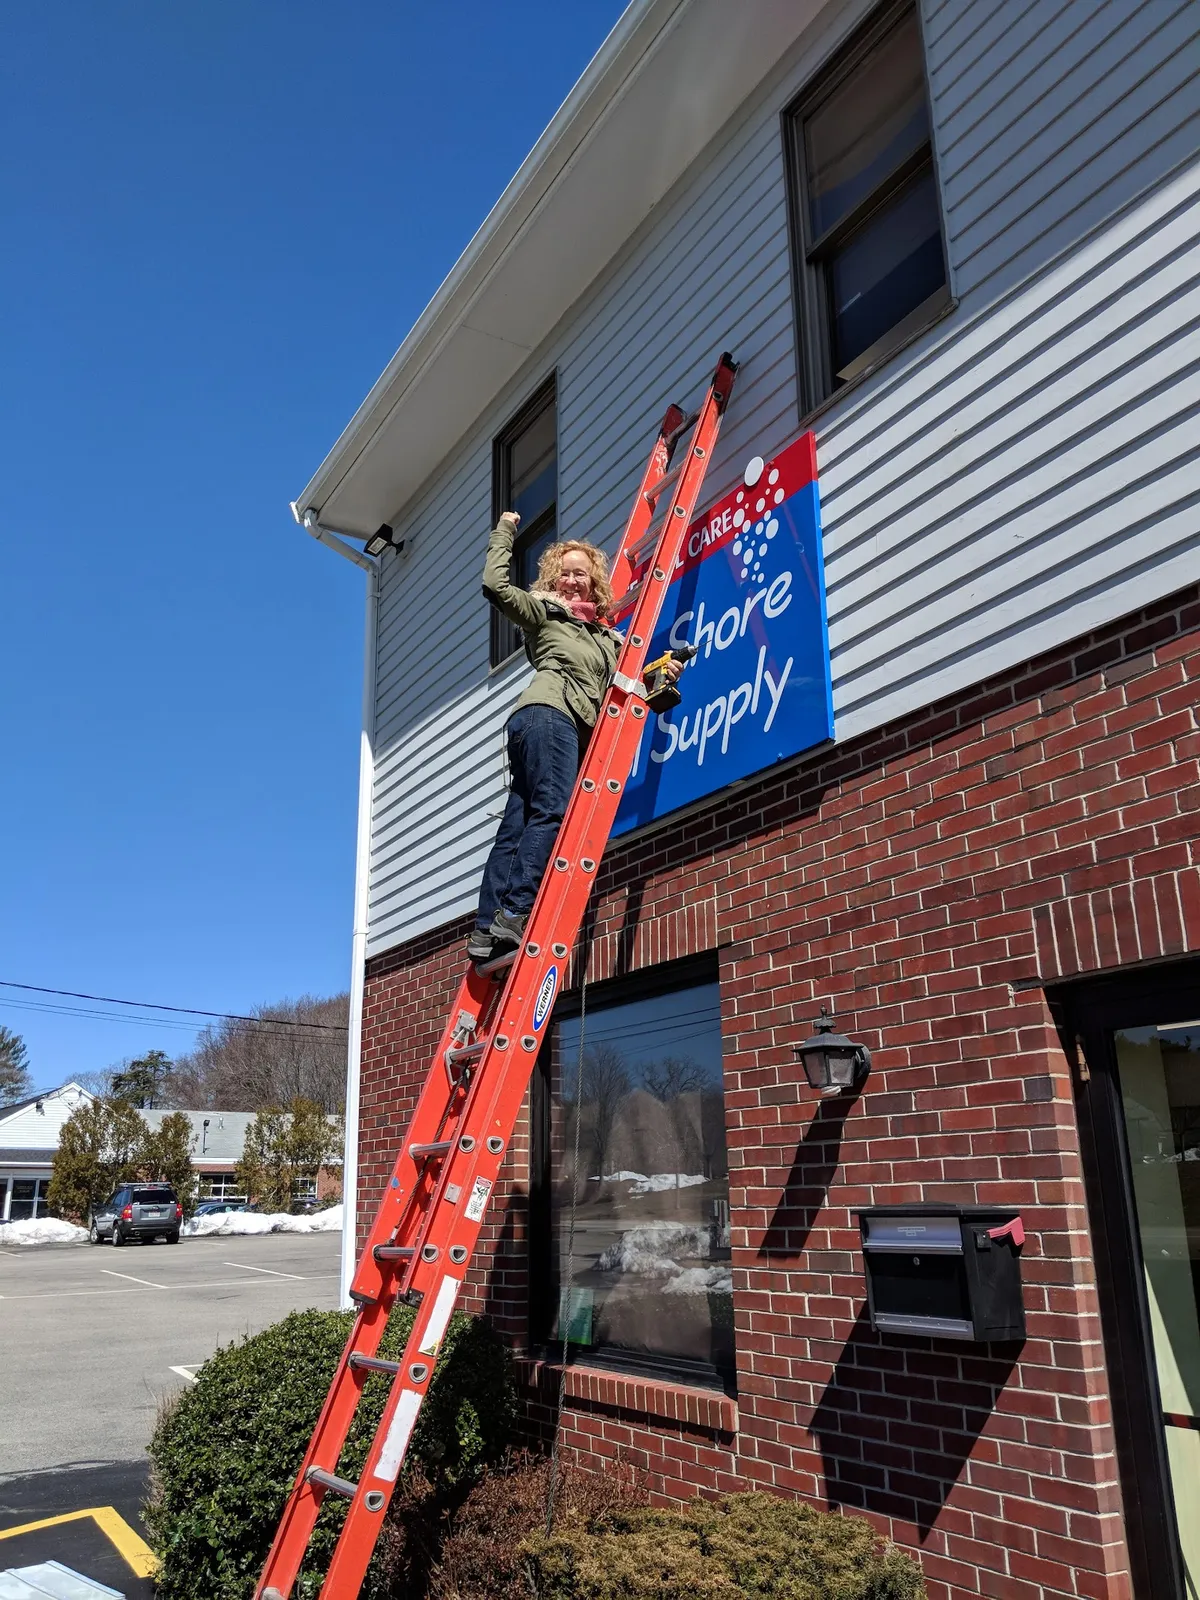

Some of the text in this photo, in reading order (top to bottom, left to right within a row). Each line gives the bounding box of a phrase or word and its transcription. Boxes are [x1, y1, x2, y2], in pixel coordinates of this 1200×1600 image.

[687, 506, 733, 558] CARE
[650, 644, 794, 767] Supply
[537, 976, 553, 1018] WERNER
